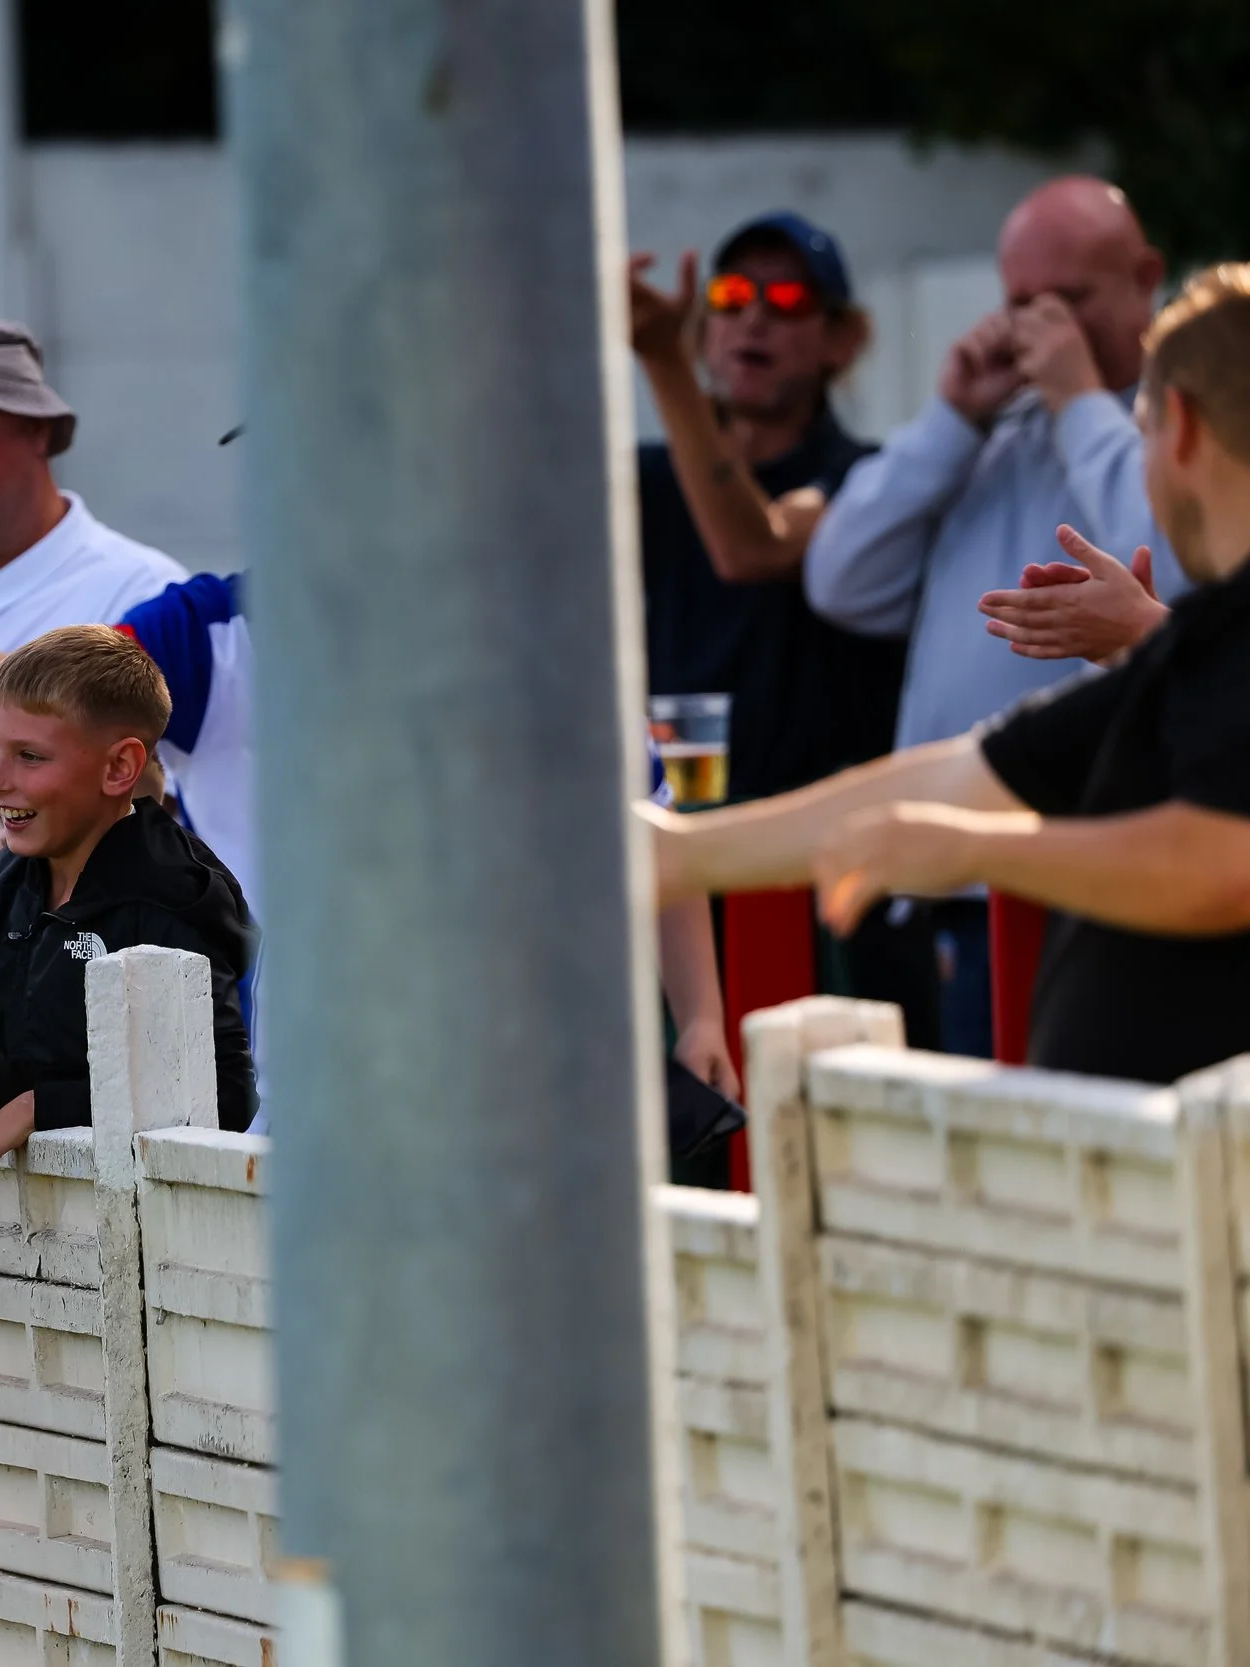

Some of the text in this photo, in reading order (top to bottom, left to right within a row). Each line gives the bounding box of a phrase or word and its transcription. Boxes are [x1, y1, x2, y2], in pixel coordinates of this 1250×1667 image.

[77, 932, 93, 942] THE
[63, 941, 92, 951] NORTH
[71, 950, 93, 960] FACE
